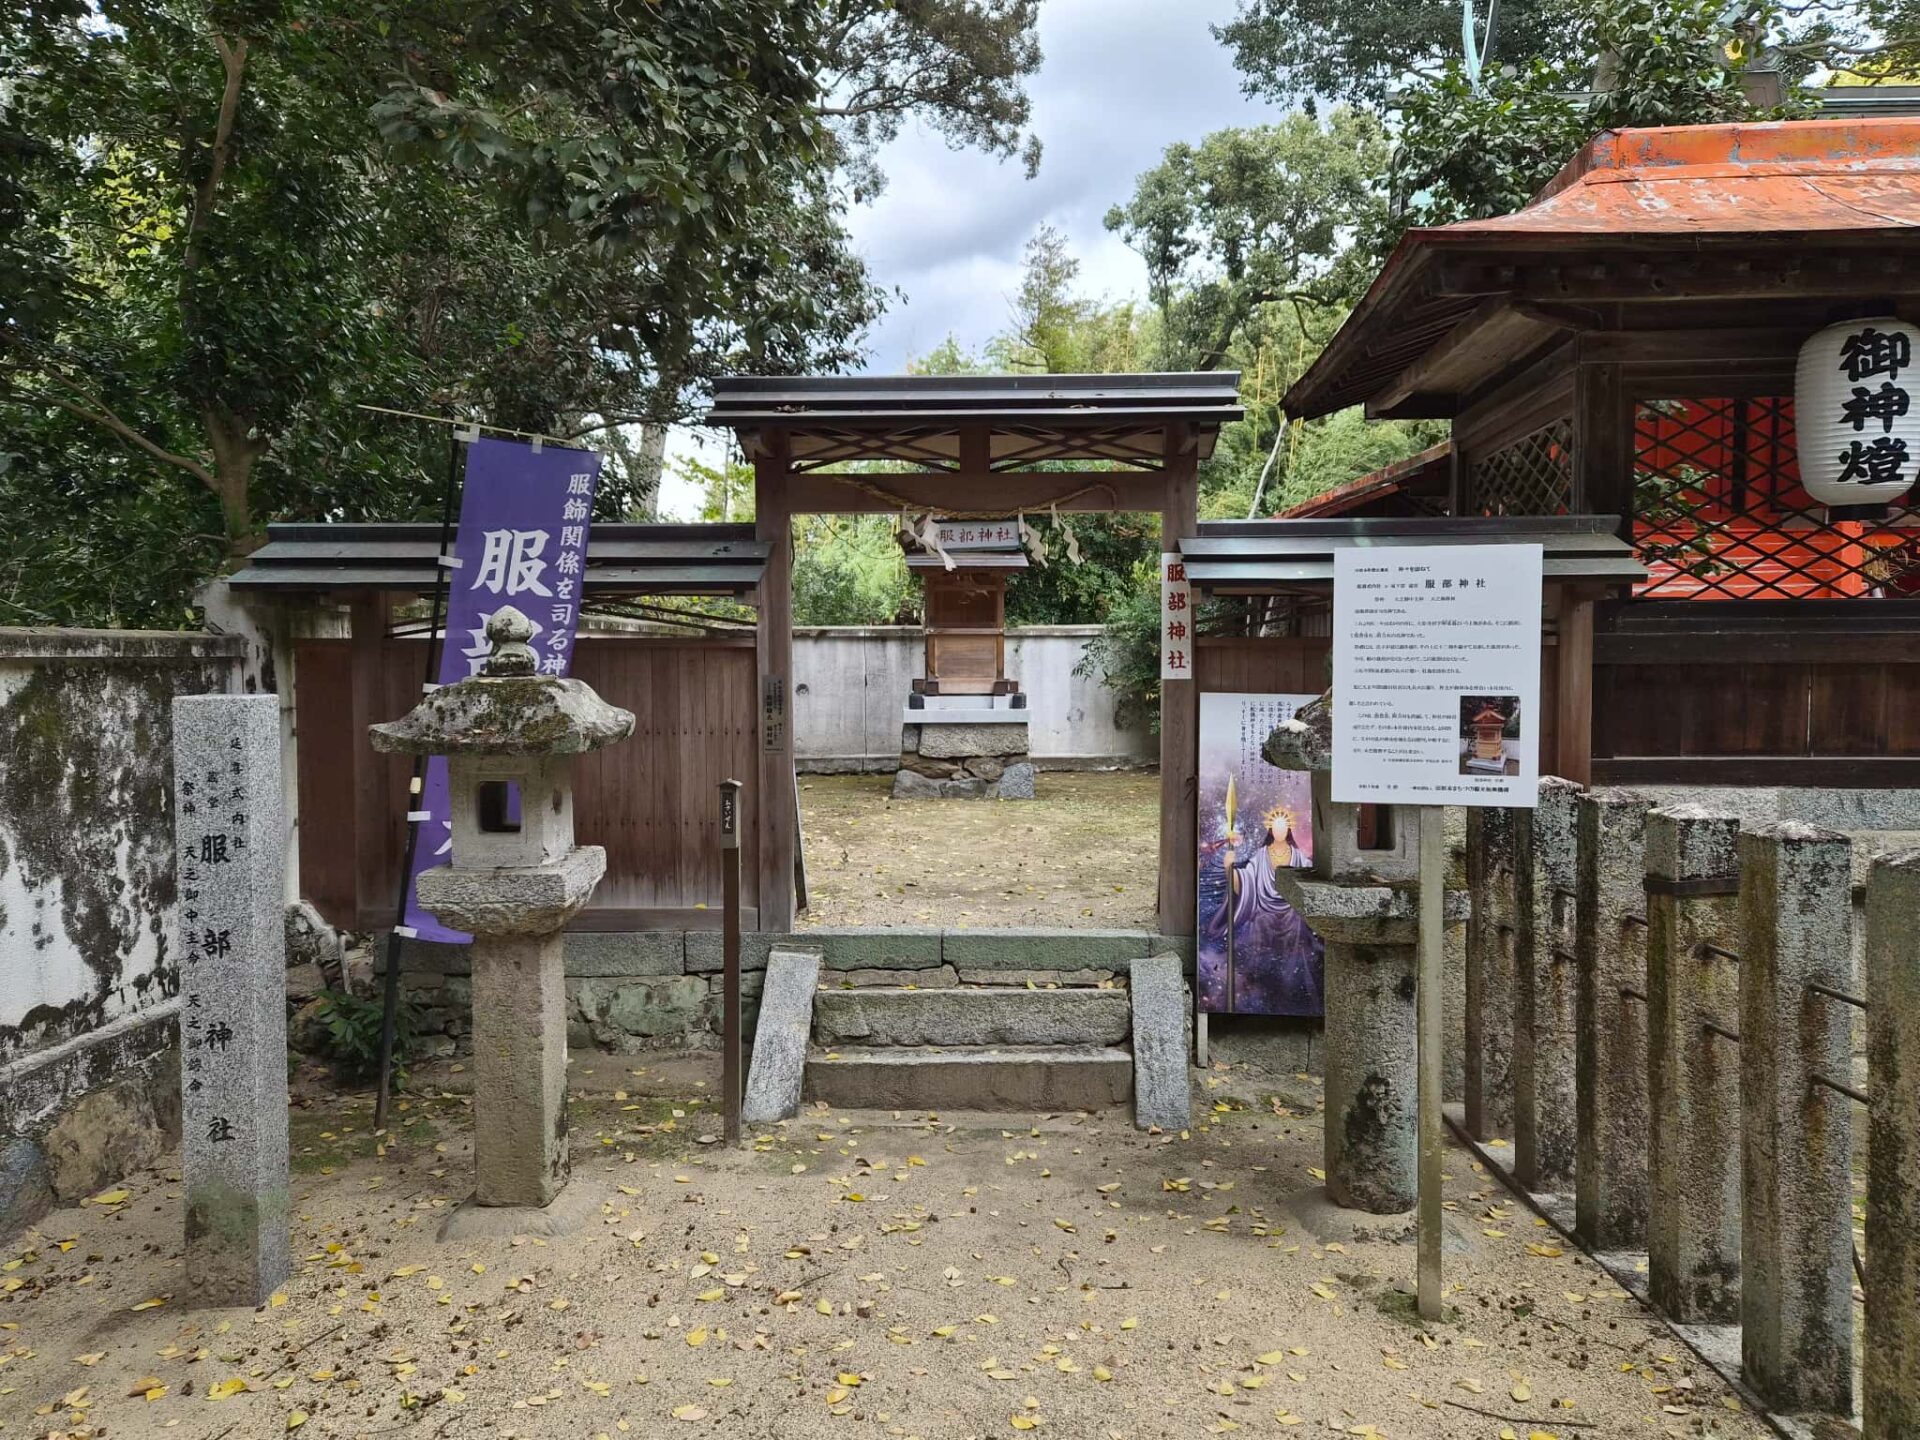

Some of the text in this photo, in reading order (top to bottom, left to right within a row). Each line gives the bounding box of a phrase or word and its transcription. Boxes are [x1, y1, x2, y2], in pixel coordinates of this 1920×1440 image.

[1837, 328, 1911, 484] 御神燈
[939, 526, 1014, 543] 服部神社
[1425, 578, 1487, 589] 服部神社
[1167, 563, 1187, 670] 服部神社
[182, 781, 197, 817] 祭神
[229, 737, 247, 849] 延喜式内社
[200, 833, 236, 1143] 服部神社
